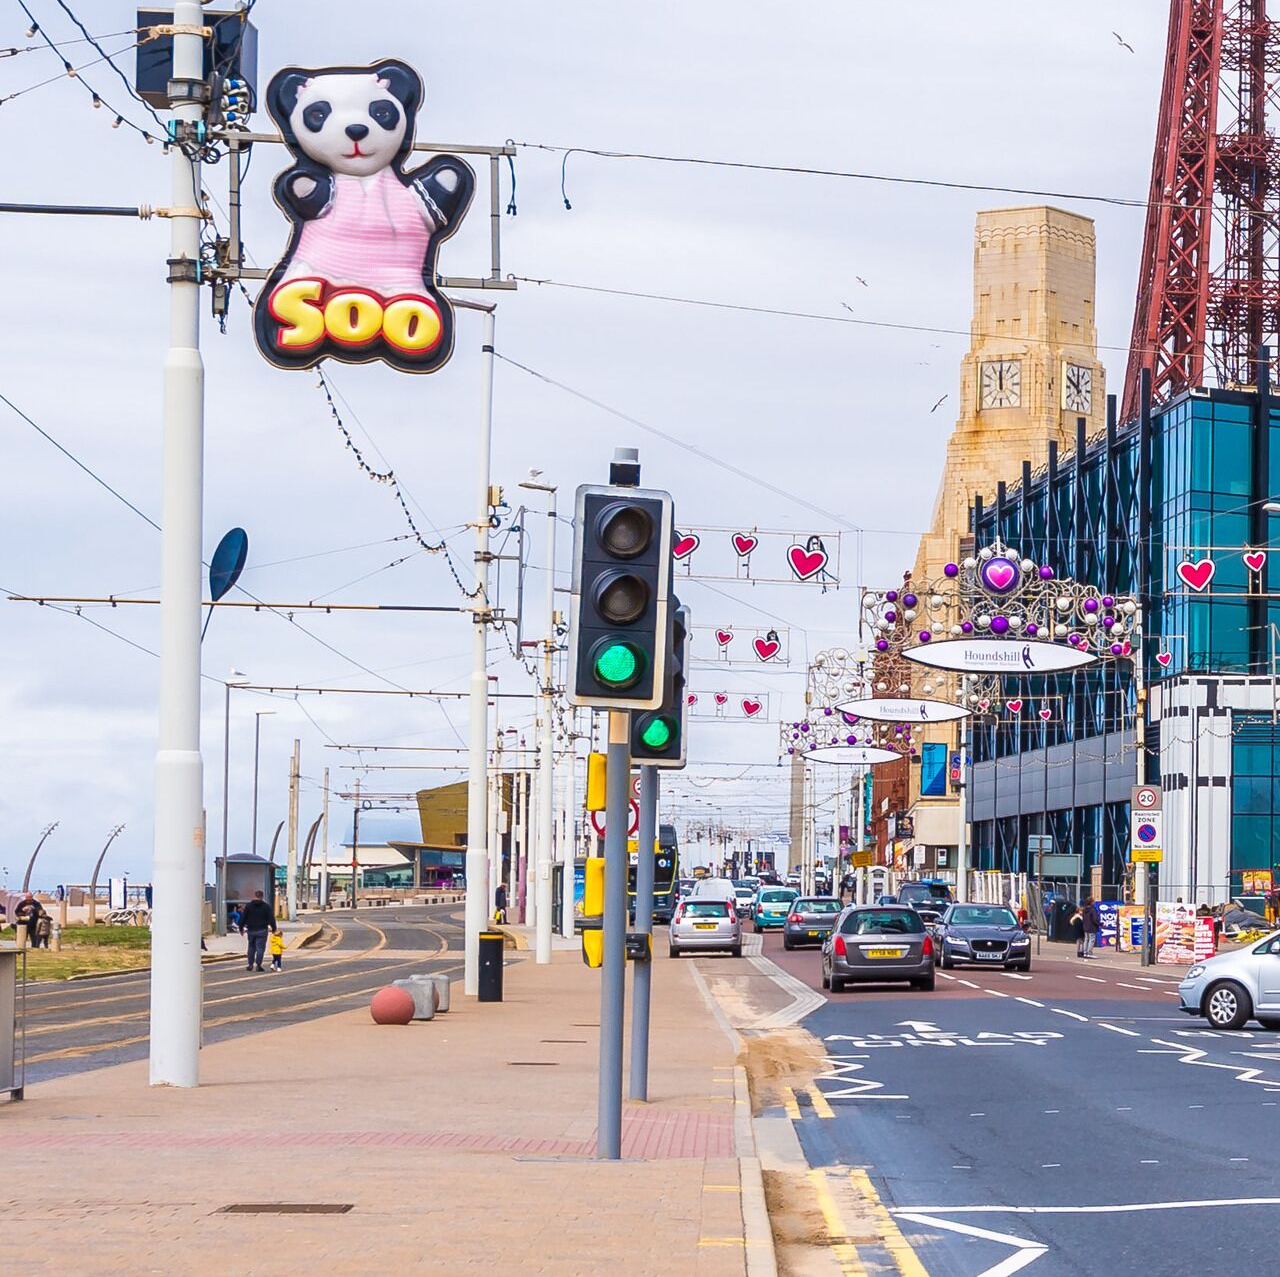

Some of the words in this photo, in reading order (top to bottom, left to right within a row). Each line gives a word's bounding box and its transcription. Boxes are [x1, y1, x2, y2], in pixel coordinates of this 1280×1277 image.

[270, 278, 443, 353] SOO
[964, 650, 1020, 662] Houndshill
[1140, 794, 1154, 802] 20
